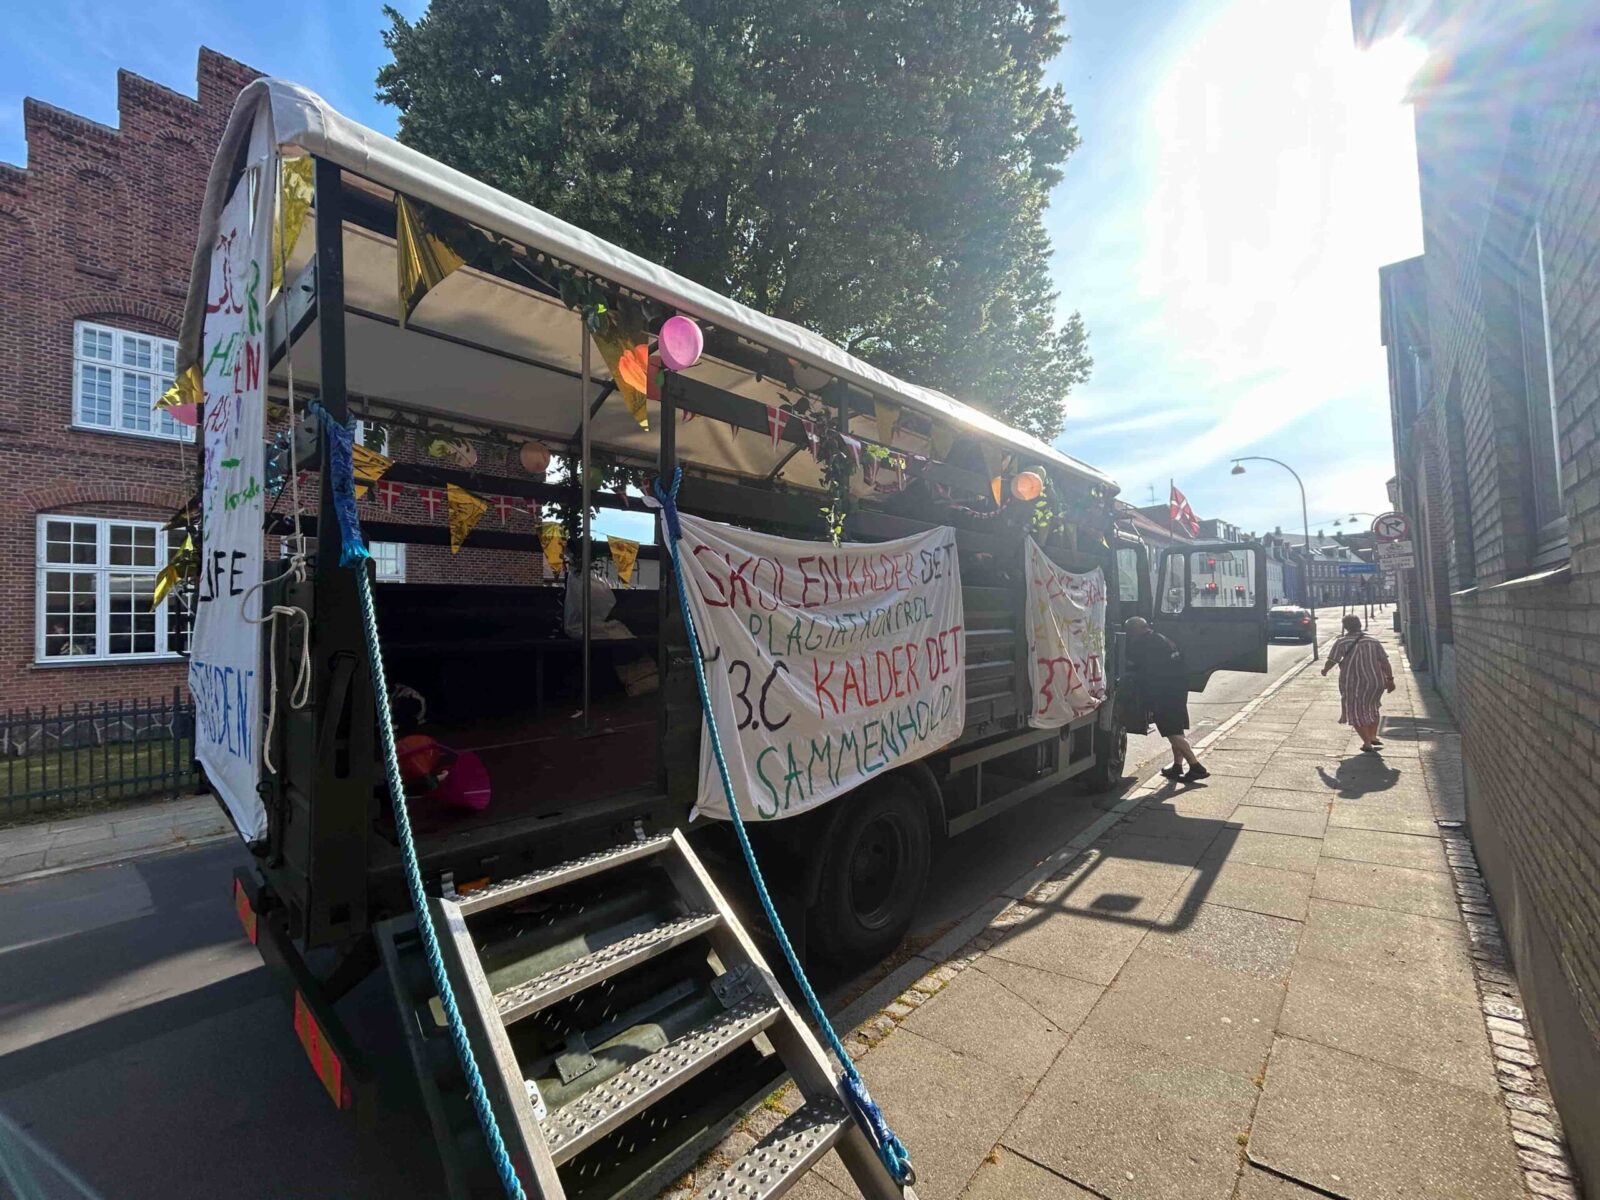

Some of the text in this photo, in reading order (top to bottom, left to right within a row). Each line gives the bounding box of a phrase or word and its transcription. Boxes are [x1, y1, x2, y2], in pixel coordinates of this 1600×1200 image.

[692, 542, 955, 612] SKOLEN KALDER DET
[749, 596, 934, 657] PLAGIATKONTROL
[728, 660, 792, 732] 3.C
[813, 642, 920, 720] KALDER
[925, 624, 962, 681] DET
[755, 684, 953, 820] SAMMENHOLD
